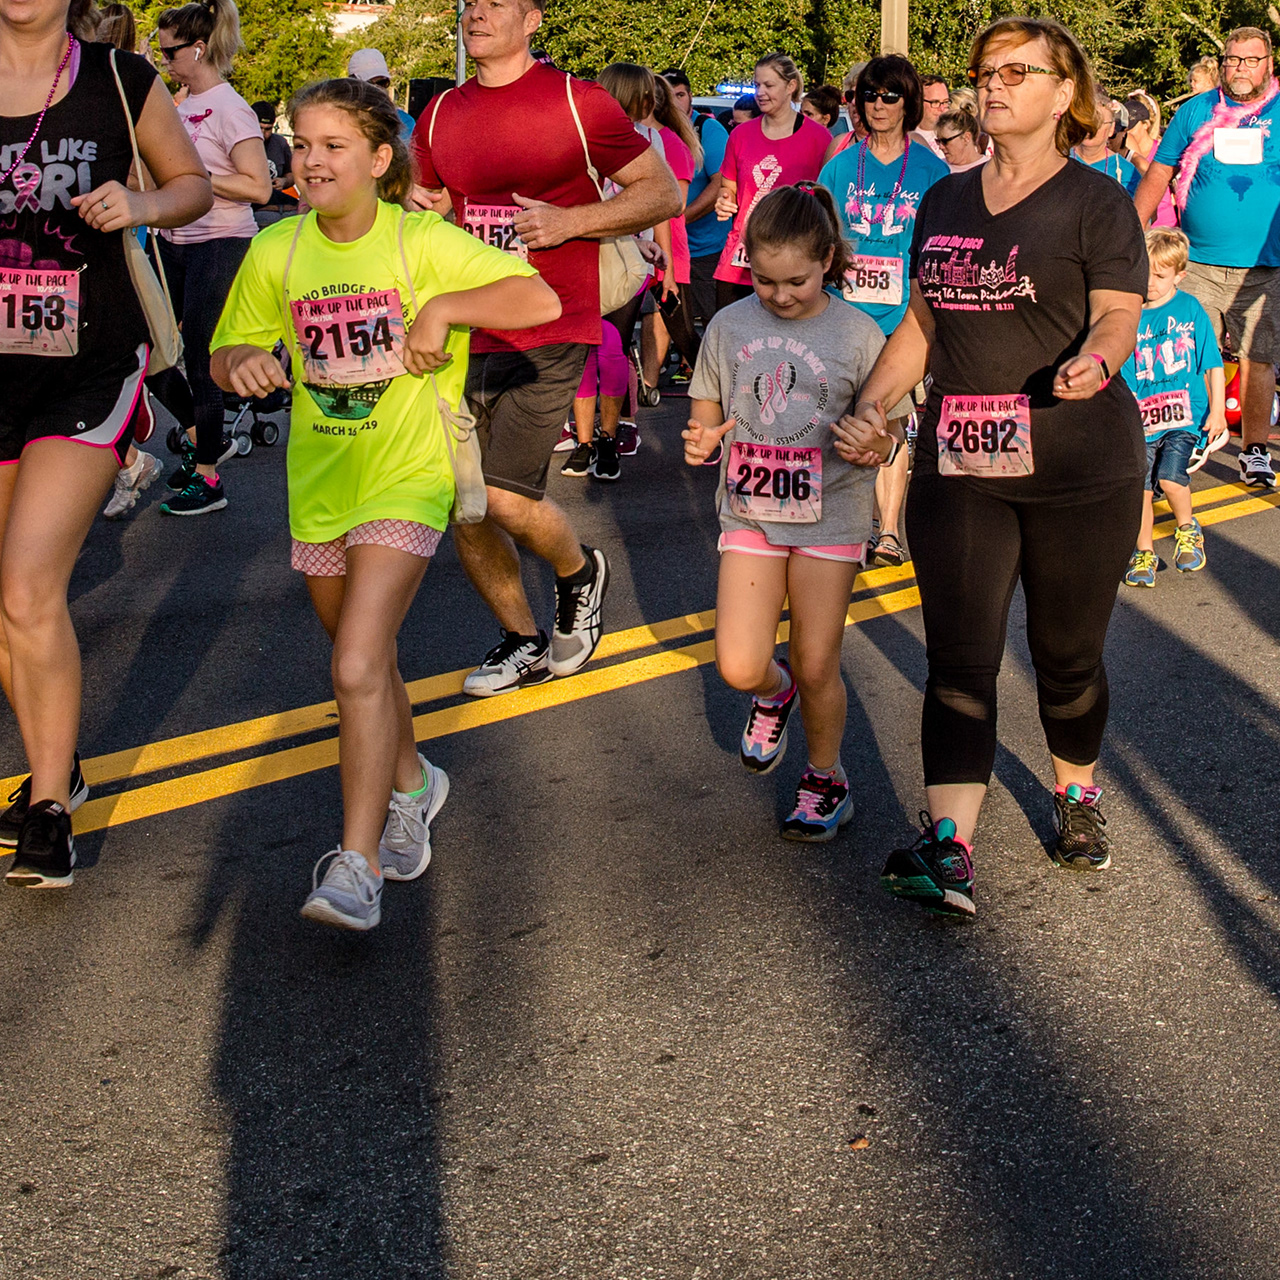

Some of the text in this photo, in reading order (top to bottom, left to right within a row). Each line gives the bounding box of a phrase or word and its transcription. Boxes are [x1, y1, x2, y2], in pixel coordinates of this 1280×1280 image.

[1248, 115, 1273, 127] Pace
[40, 138, 98, 164] LIKE
[847, 182, 875, 197] Pink
[478, 208, 489, 217] UP
[490, 208, 502, 218] THE
[504, 209, 520, 218] PAC
[9, 273, 21, 285] UP
[25, 274, 42, 286] THE
[46, 274, 69, 287] PACE
[855, 269, 891, 290] 653
[297, 289, 320, 302] NO
[321, 283, 367, 298] BRIDGE
[942, 287, 955, 299] The
[956, 288, 979, 300] Town
[980, 289, 1002, 301] Pink
[328, 302, 341, 314] UP
[345, 299, 364, 313] THE
[367, 294, 390, 309] PACE
[1167, 315, 1195, 334] Pace
[304, 316, 394, 360] 2154
[767, 336, 783, 349] UP
[817, 376, 829, 412] PURPOSE
[967, 401, 978, 412] UP
[981, 400, 995, 412] THE
[998, 400, 1018, 412] PACE
[312, 422, 345, 436] MARCH
[359, 420, 378, 432] 19
[730, 410, 769, 444] COMMUNITY
[776, 416, 820, 446] AWARENESS
[946, 418, 1019, 453] 2692
[760, 448, 772, 459] UP
[775, 449, 791, 461] THE
[793, 451, 813, 462] PACE
[735, 464, 811, 501] 2206
